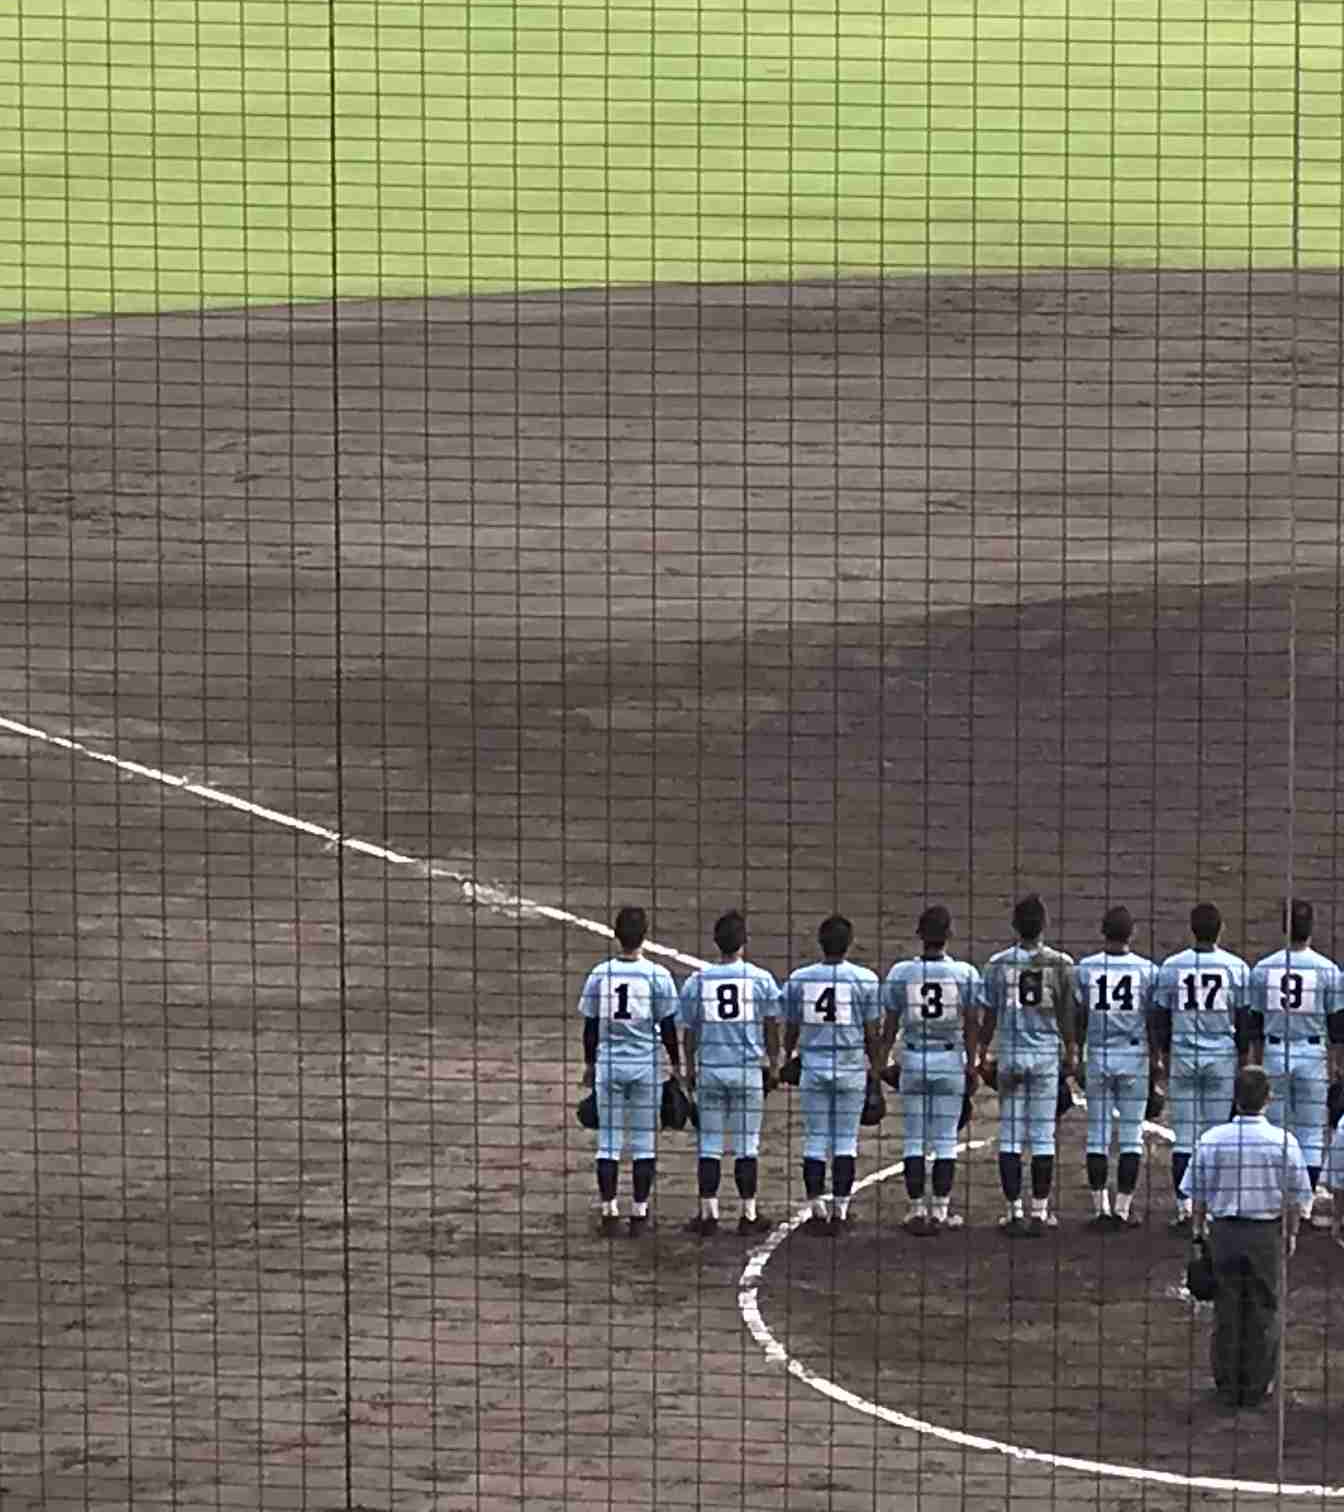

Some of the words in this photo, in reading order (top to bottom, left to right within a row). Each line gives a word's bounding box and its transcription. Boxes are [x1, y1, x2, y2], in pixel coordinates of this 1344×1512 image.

[613, 984, 632, 1020] 1
[716, 984, 740, 1020] 8
[815, 987, 837, 1022] 4
[920, 983, 943, 1019] 3
[1094, 975, 1134, 1010] 14
[1183, 974, 1223, 1010] 17
[1280, 974, 1303, 1009] 9
